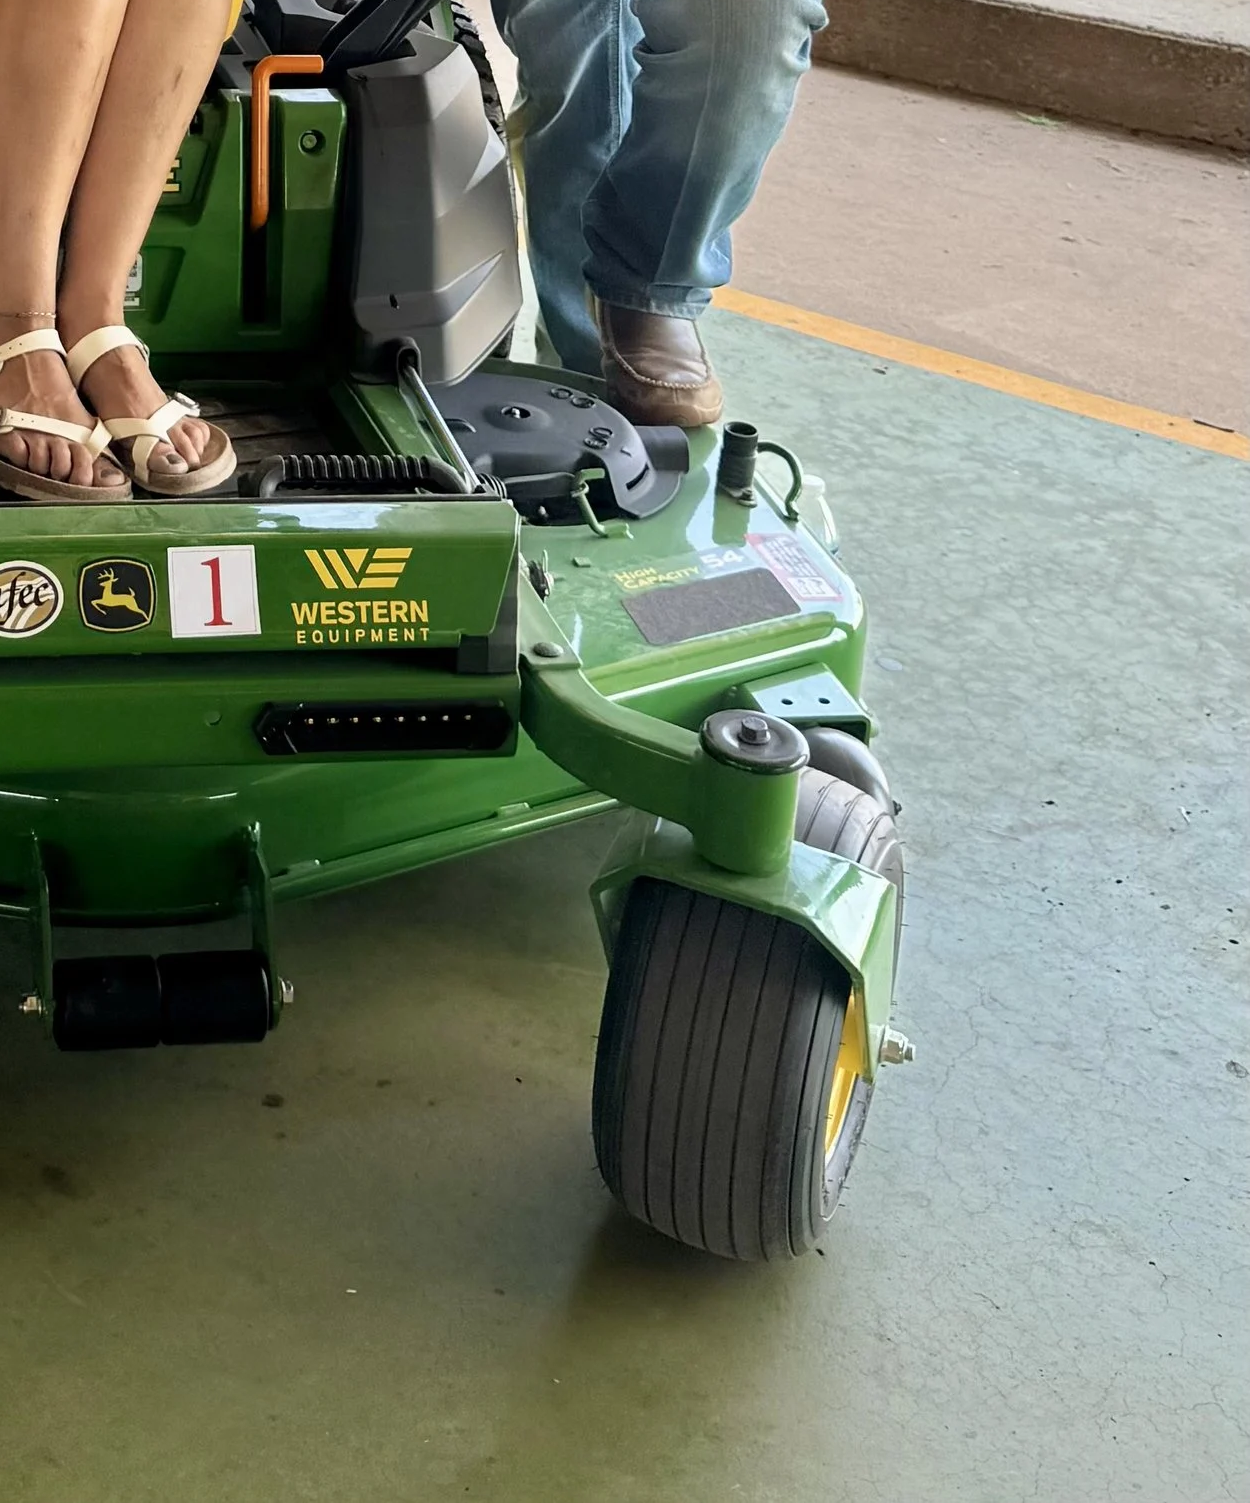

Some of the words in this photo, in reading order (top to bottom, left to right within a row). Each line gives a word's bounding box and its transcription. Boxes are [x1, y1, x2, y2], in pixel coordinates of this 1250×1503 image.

[701, 550, 744, 569] 54
[623, 566, 699, 590] CAPACITY
[200, 556, 233, 626] 1
[291, 600, 429, 625] WESTERN
[296, 628, 429, 644] EQUIPMENT
